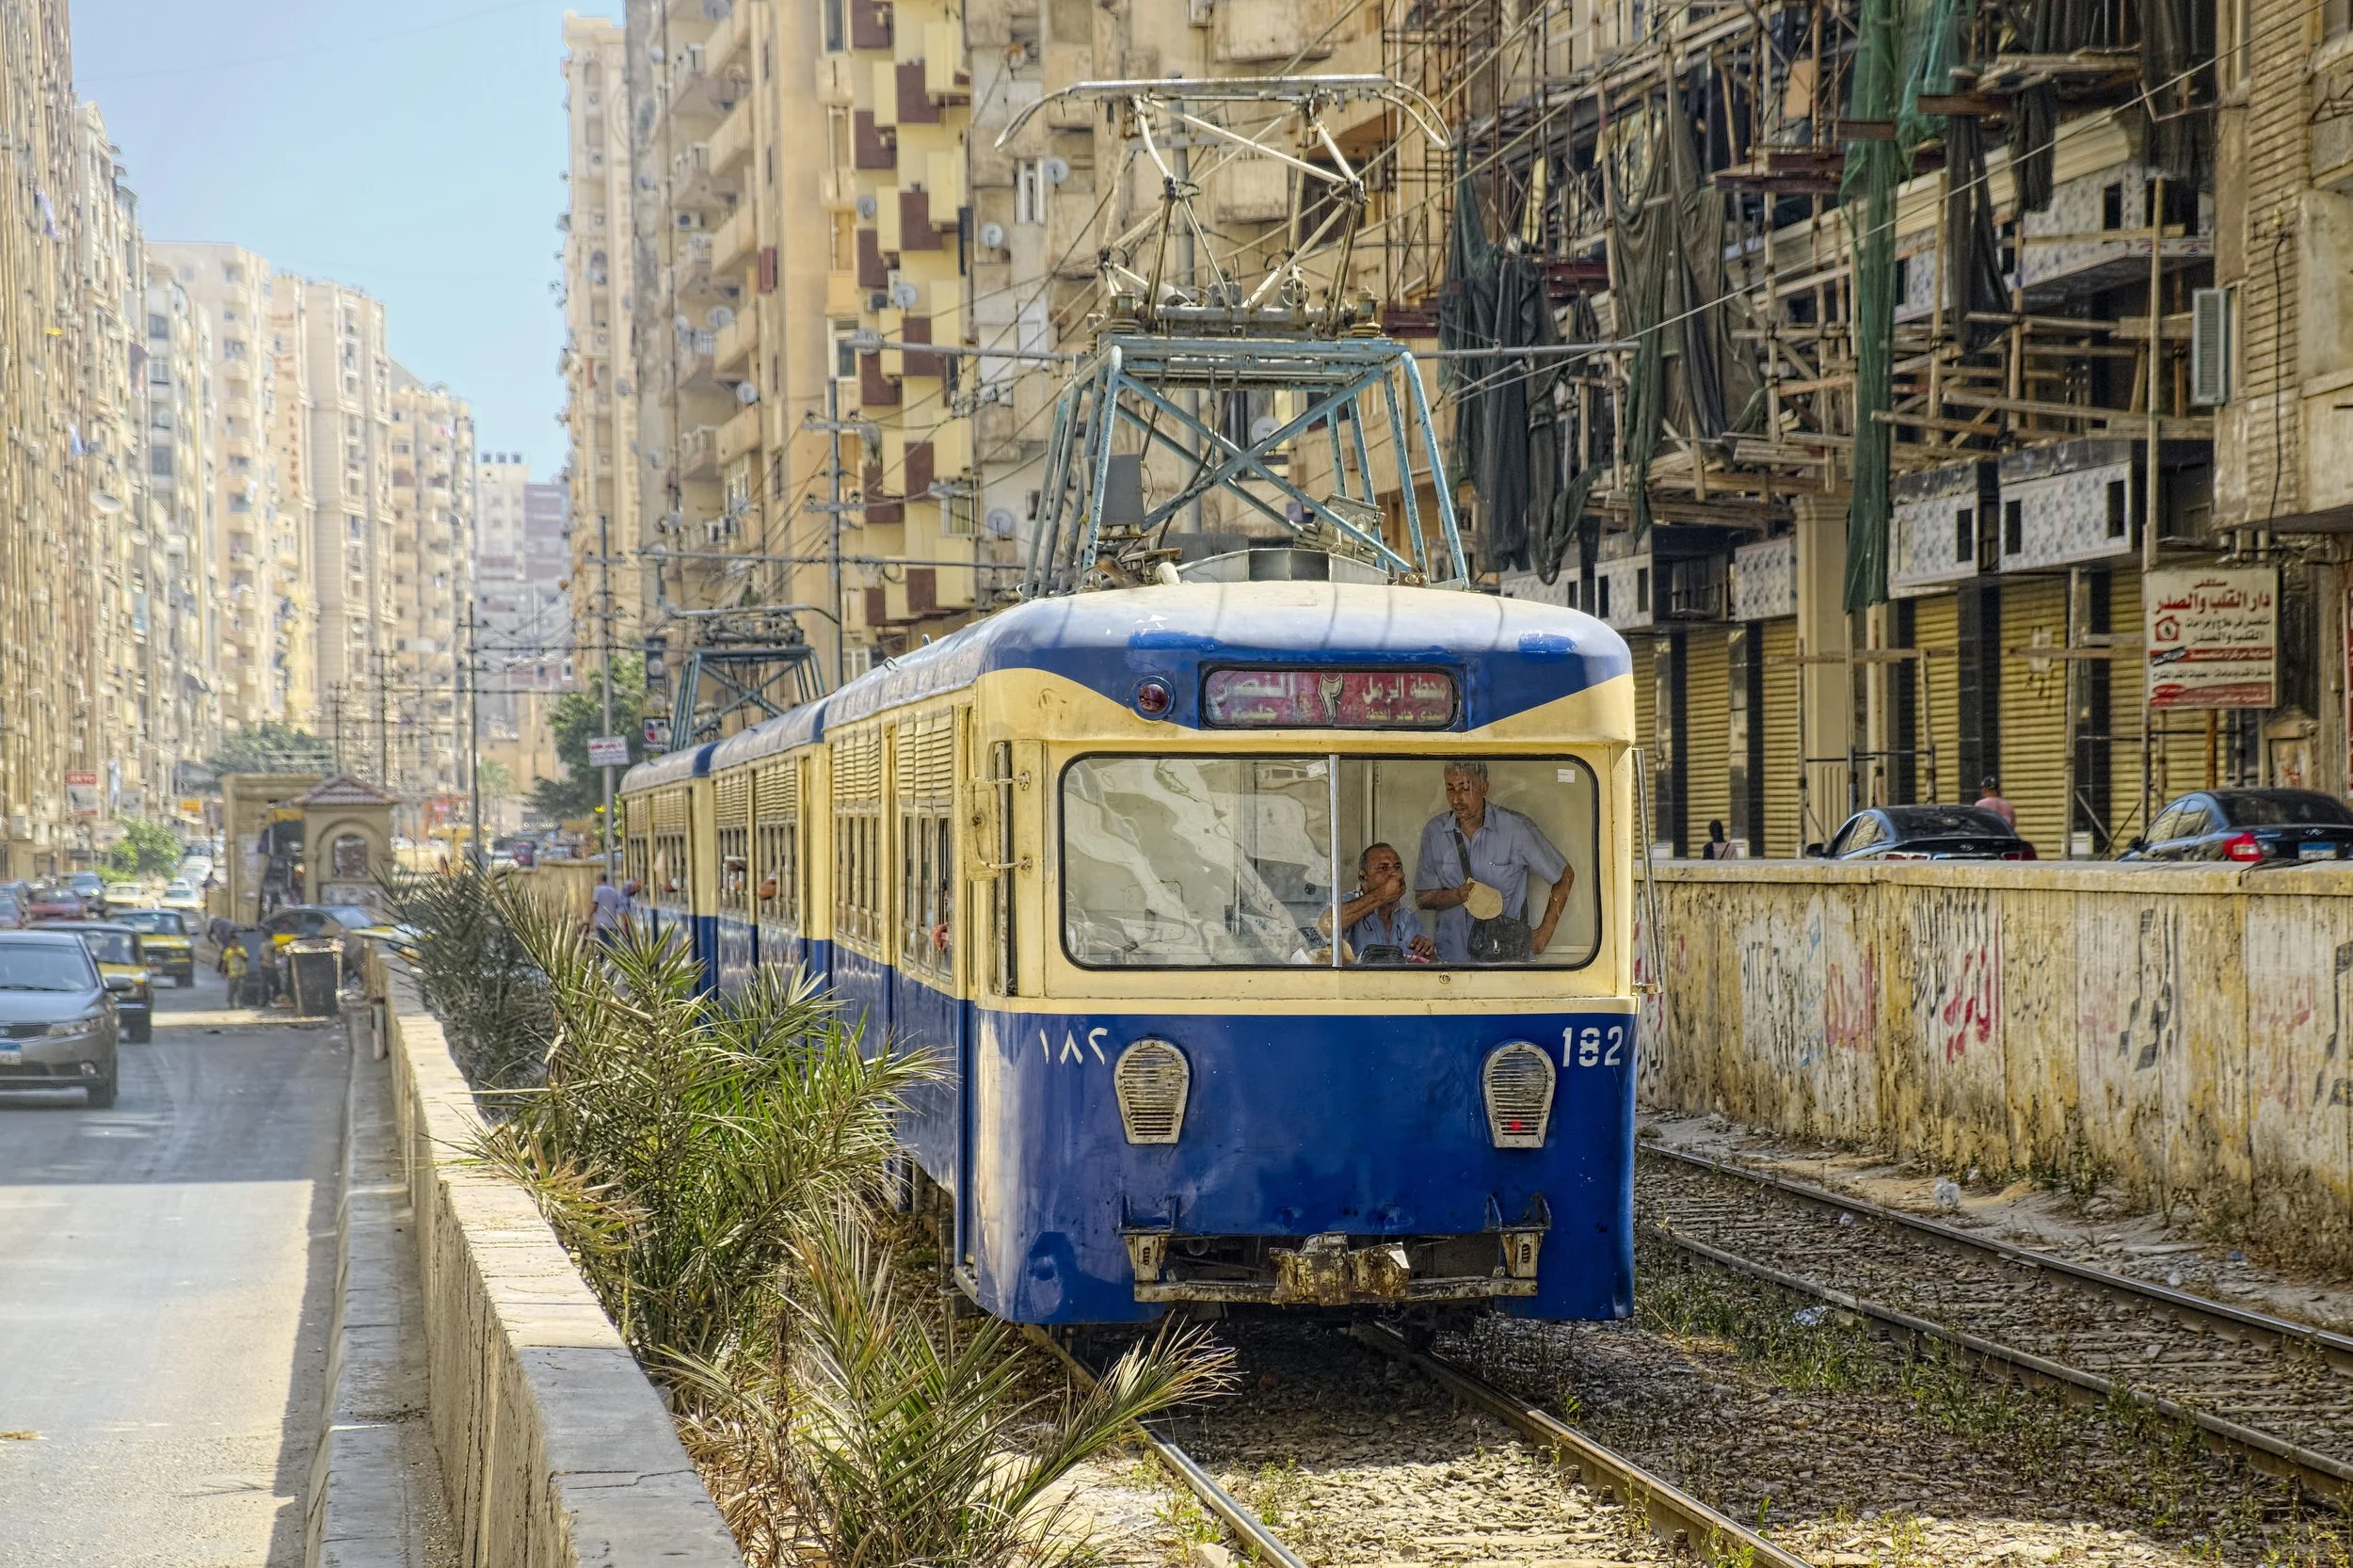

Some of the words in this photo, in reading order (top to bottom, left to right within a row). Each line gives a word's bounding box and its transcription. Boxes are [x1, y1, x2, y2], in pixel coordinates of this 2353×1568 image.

[2154, 591, 2206, 614] والصدر
[2210, 589, 2248, 614] القلب
[2249, 590, 2271, 612] دار
[2191, 632, 2232, 646] والصدر
[2234, 629, 2265, 644] القلب
[1318, 672, 1344, 724] ٢
[1362, 674, 1404, 706] الرمل
[1410, 674, 1448, 700] محطة
[1396, 708, 1414, 722] جابر
[1039, 1027, 1108, 1065] ١٨٢
[1562, 1025, 1624, 1067] 182
